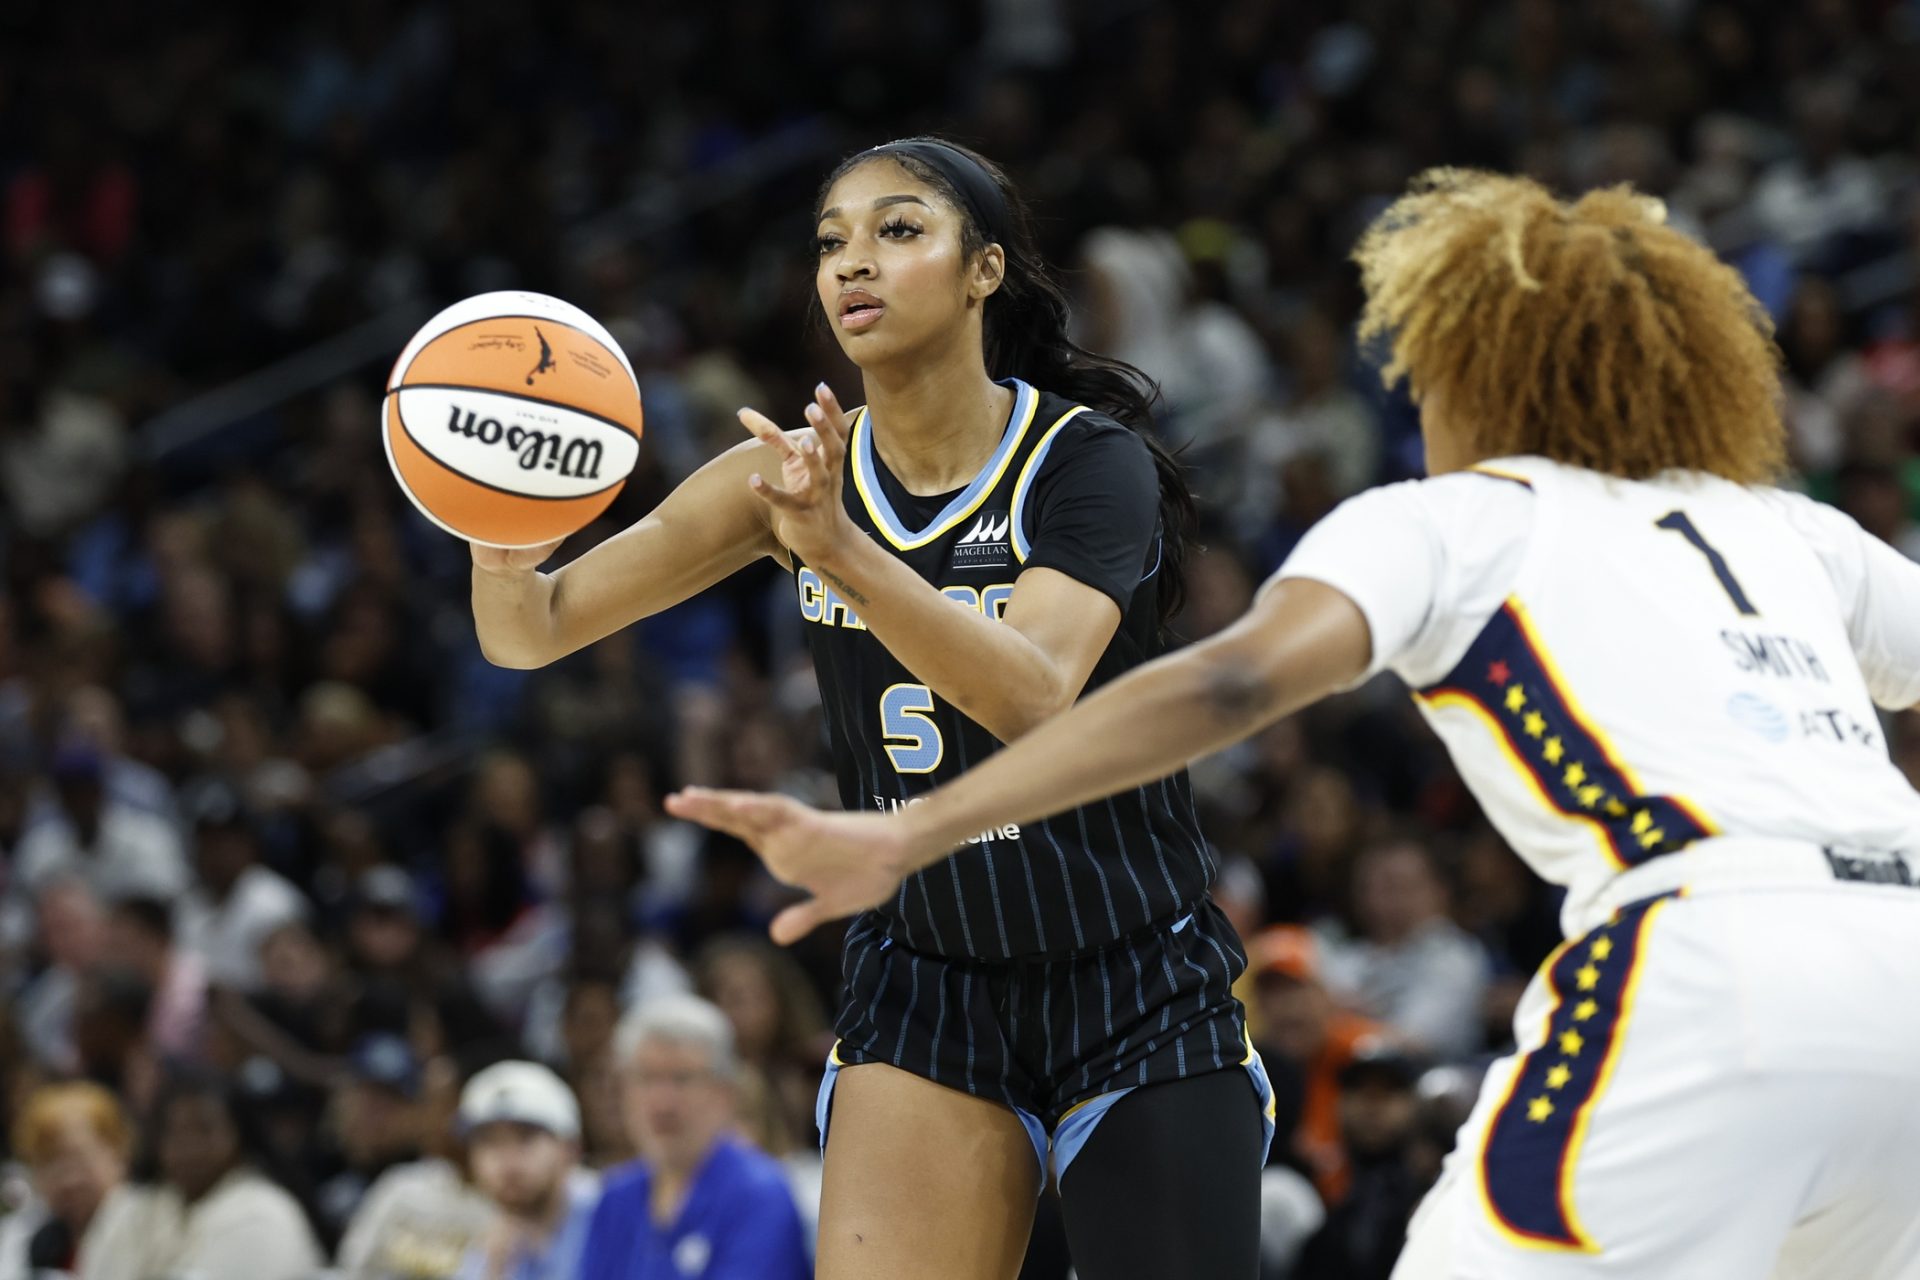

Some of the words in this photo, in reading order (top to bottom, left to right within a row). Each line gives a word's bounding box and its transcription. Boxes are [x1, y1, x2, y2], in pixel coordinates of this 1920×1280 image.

[447, 404, 604, 480] Wilson
[953, 545, 1009, 557] MAGELLAN
[1654, 510, 1760, 616] 1
[1719, 629, 1832, 684] SMITH
[880, 683, 943, 773] 5
